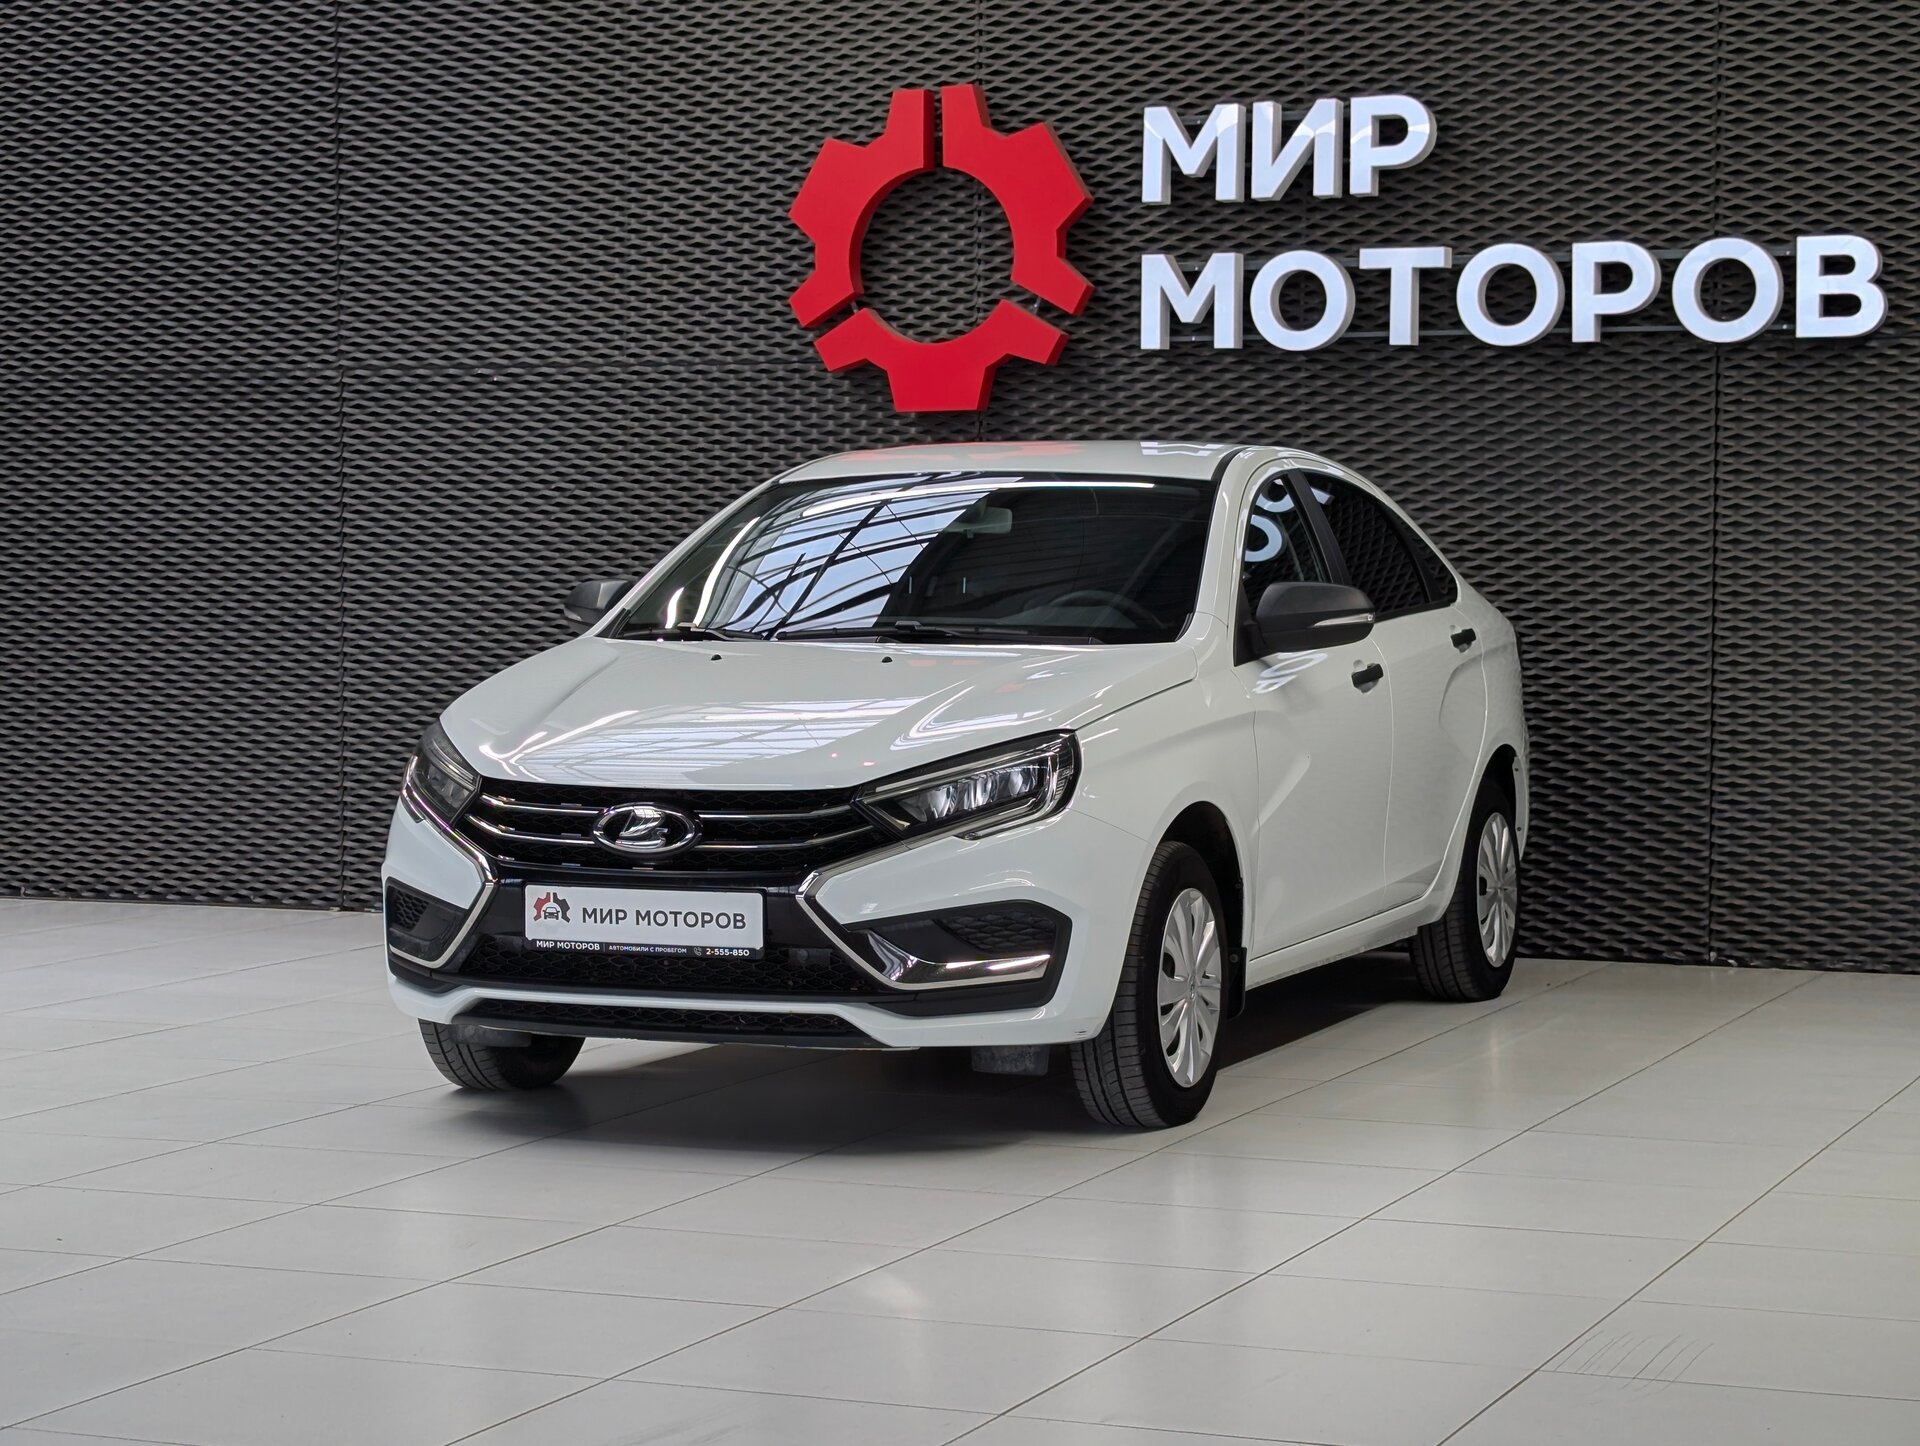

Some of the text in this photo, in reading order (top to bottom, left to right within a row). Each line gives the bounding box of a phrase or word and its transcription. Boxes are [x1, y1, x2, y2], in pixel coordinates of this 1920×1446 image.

[1141, 94, 1437, 203] МИР
[1140, 234, 1887, 351] МОТОРОВ
[582, 907, 746, 930] МИР МОТОРОВ
[536, 940, 600, 951] МИР МОТОРОВ
[655, 946, 687, 954] ПРОБЕГОМ
[706, 947, 750, 957] 2-555-850
